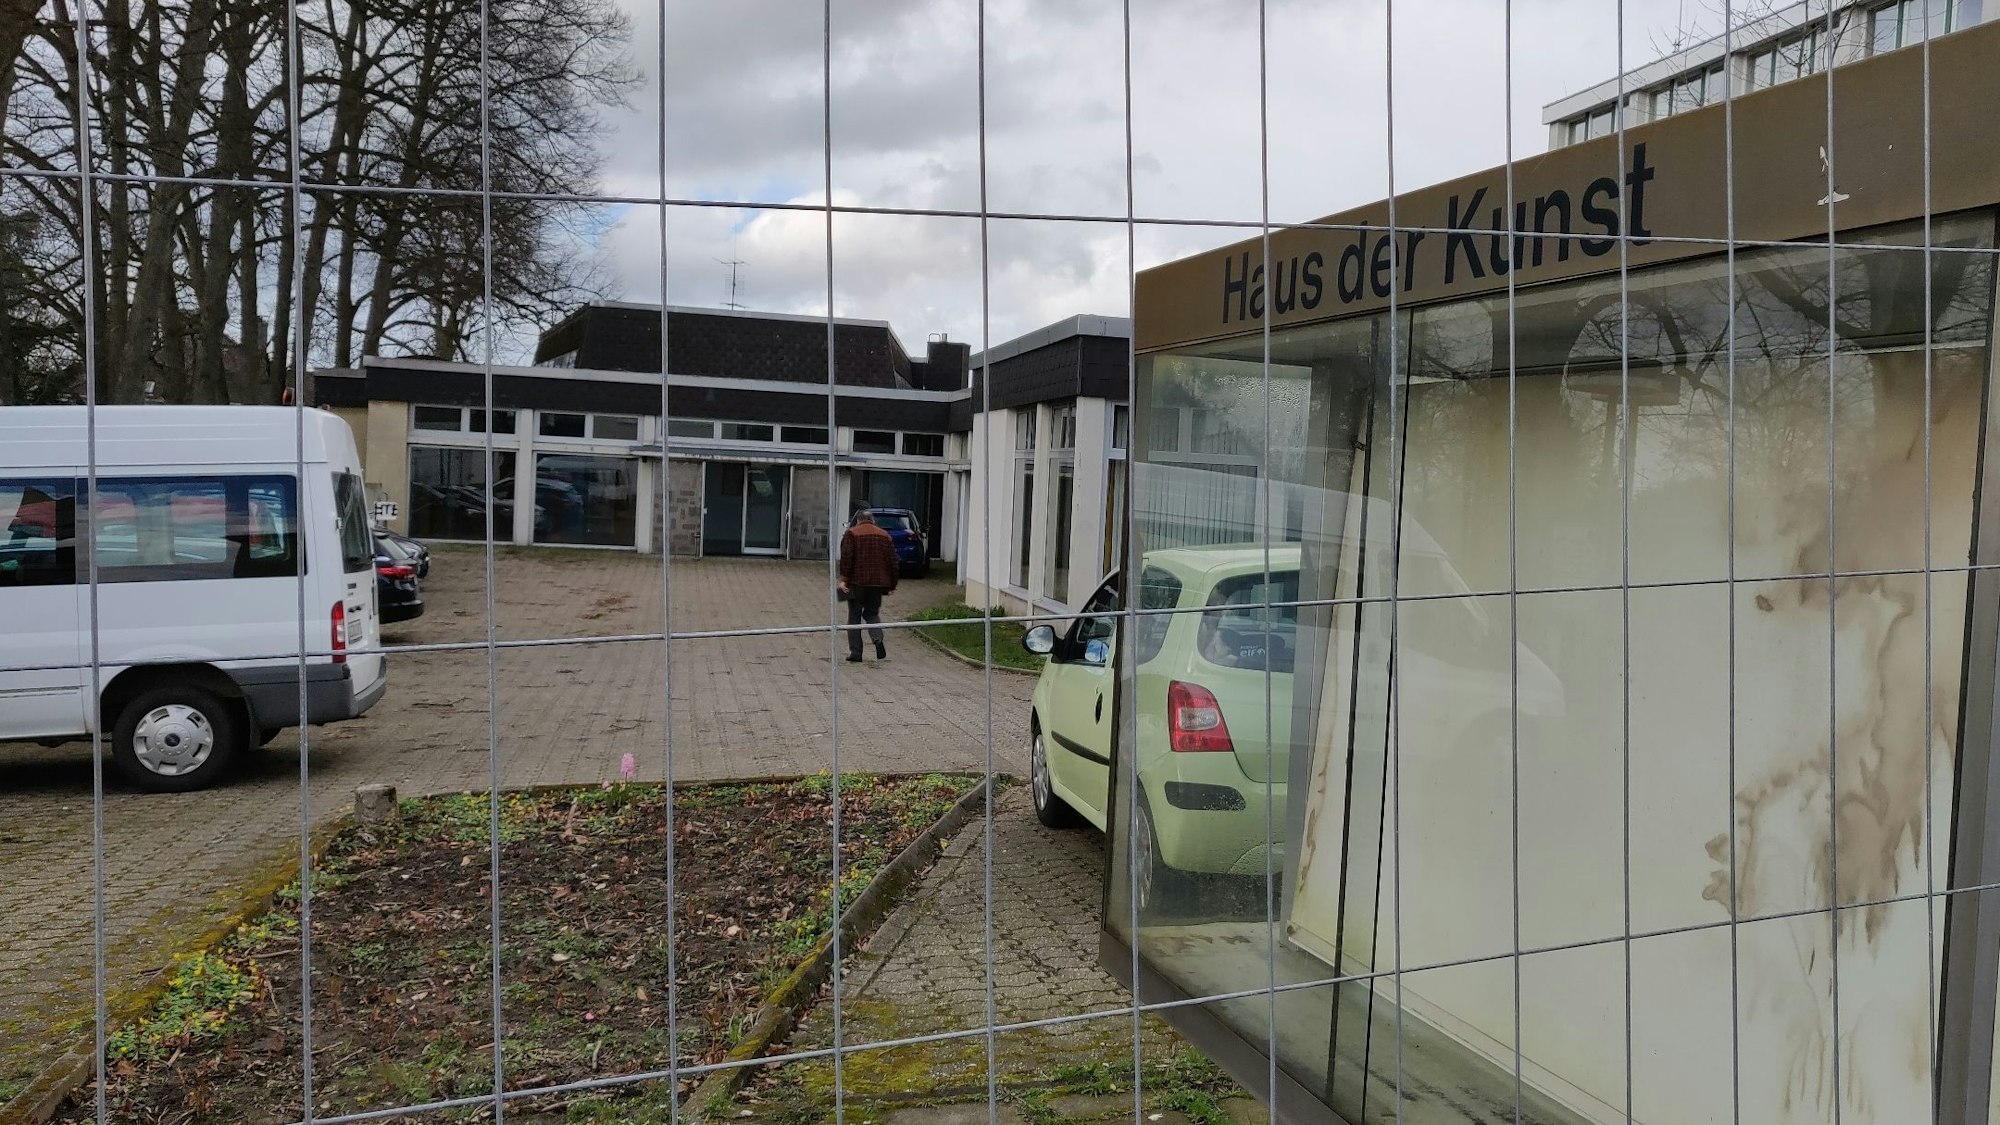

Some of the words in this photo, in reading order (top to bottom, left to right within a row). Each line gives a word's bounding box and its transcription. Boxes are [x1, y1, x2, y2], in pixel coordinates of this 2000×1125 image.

[1222, 250, 1323, 324] Haus
[1337, 220, 1427, 303] der
[1444, 142, 1655, 284] Kunst
